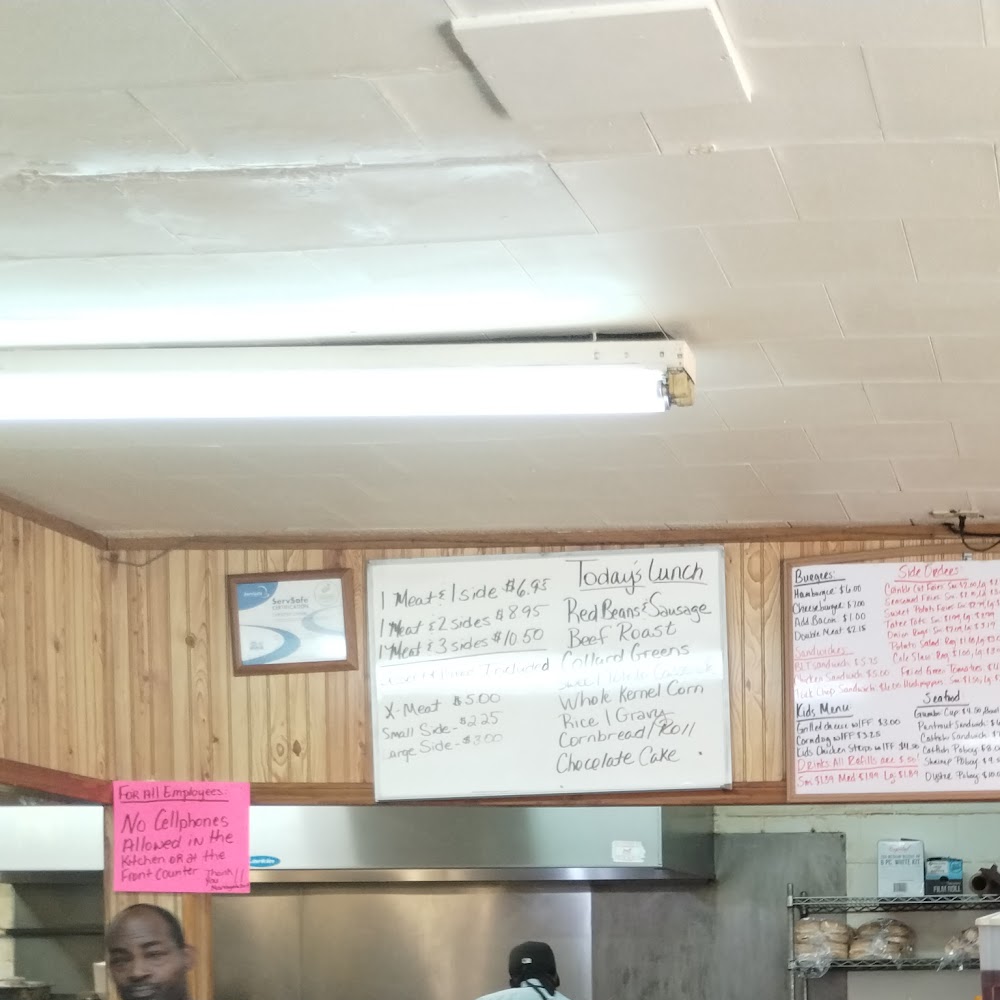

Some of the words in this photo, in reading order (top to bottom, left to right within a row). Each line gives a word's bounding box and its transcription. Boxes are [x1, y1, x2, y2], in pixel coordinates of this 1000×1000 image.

[565, 558, 642, 595] Today's
[648, 558, 704, 583] Lunch
[272, 596, 309, 606] ServSafe
[393, 588, 438, 608] Meat
[563, 597, 598, 624] Red
[602, 598, 641, 620] Beans
[647, 592, 712, 623] Sausage
[389, 619, 424, 638] Meat
[438, 616, 449, 631] 2
[450, 616, 491, 631] sides
[568, 625, 612, 649] Beef
[616, 621, 677, 642] Roast
[385, 641, 422, 660] Meat
[436, 637, 447, 655] 3
[450, 636, 489, 653] sides
[630, 642, 690, 662] Greens
[558, 687, 612, 710] Whole
[619, 683, 661, 704] Kernel
[666, 679, 704, 697] Corn
[558, 712, 599, 729] Rice
[615, 706, 676, 727] Gravy
[796, 703, 816, 719] Kids
[382, 727, 414, 741] Small
[556, 751, 635, 774] Chocolate
[638, 745, 680, 767] Cake
[120, 811, 146, 834] No
[154, 808, 229, 833] Cellphones
[122, 835, 182, 853] Allowed
[209, 829, 234, 844] the
[121, 854, 165, 868] Kitchen
[186, 852, 197, 864] at
[203, 848, 226, 862] the
[121, 868, 153, 882] Front
[155, 866, 199, 881] Counter
